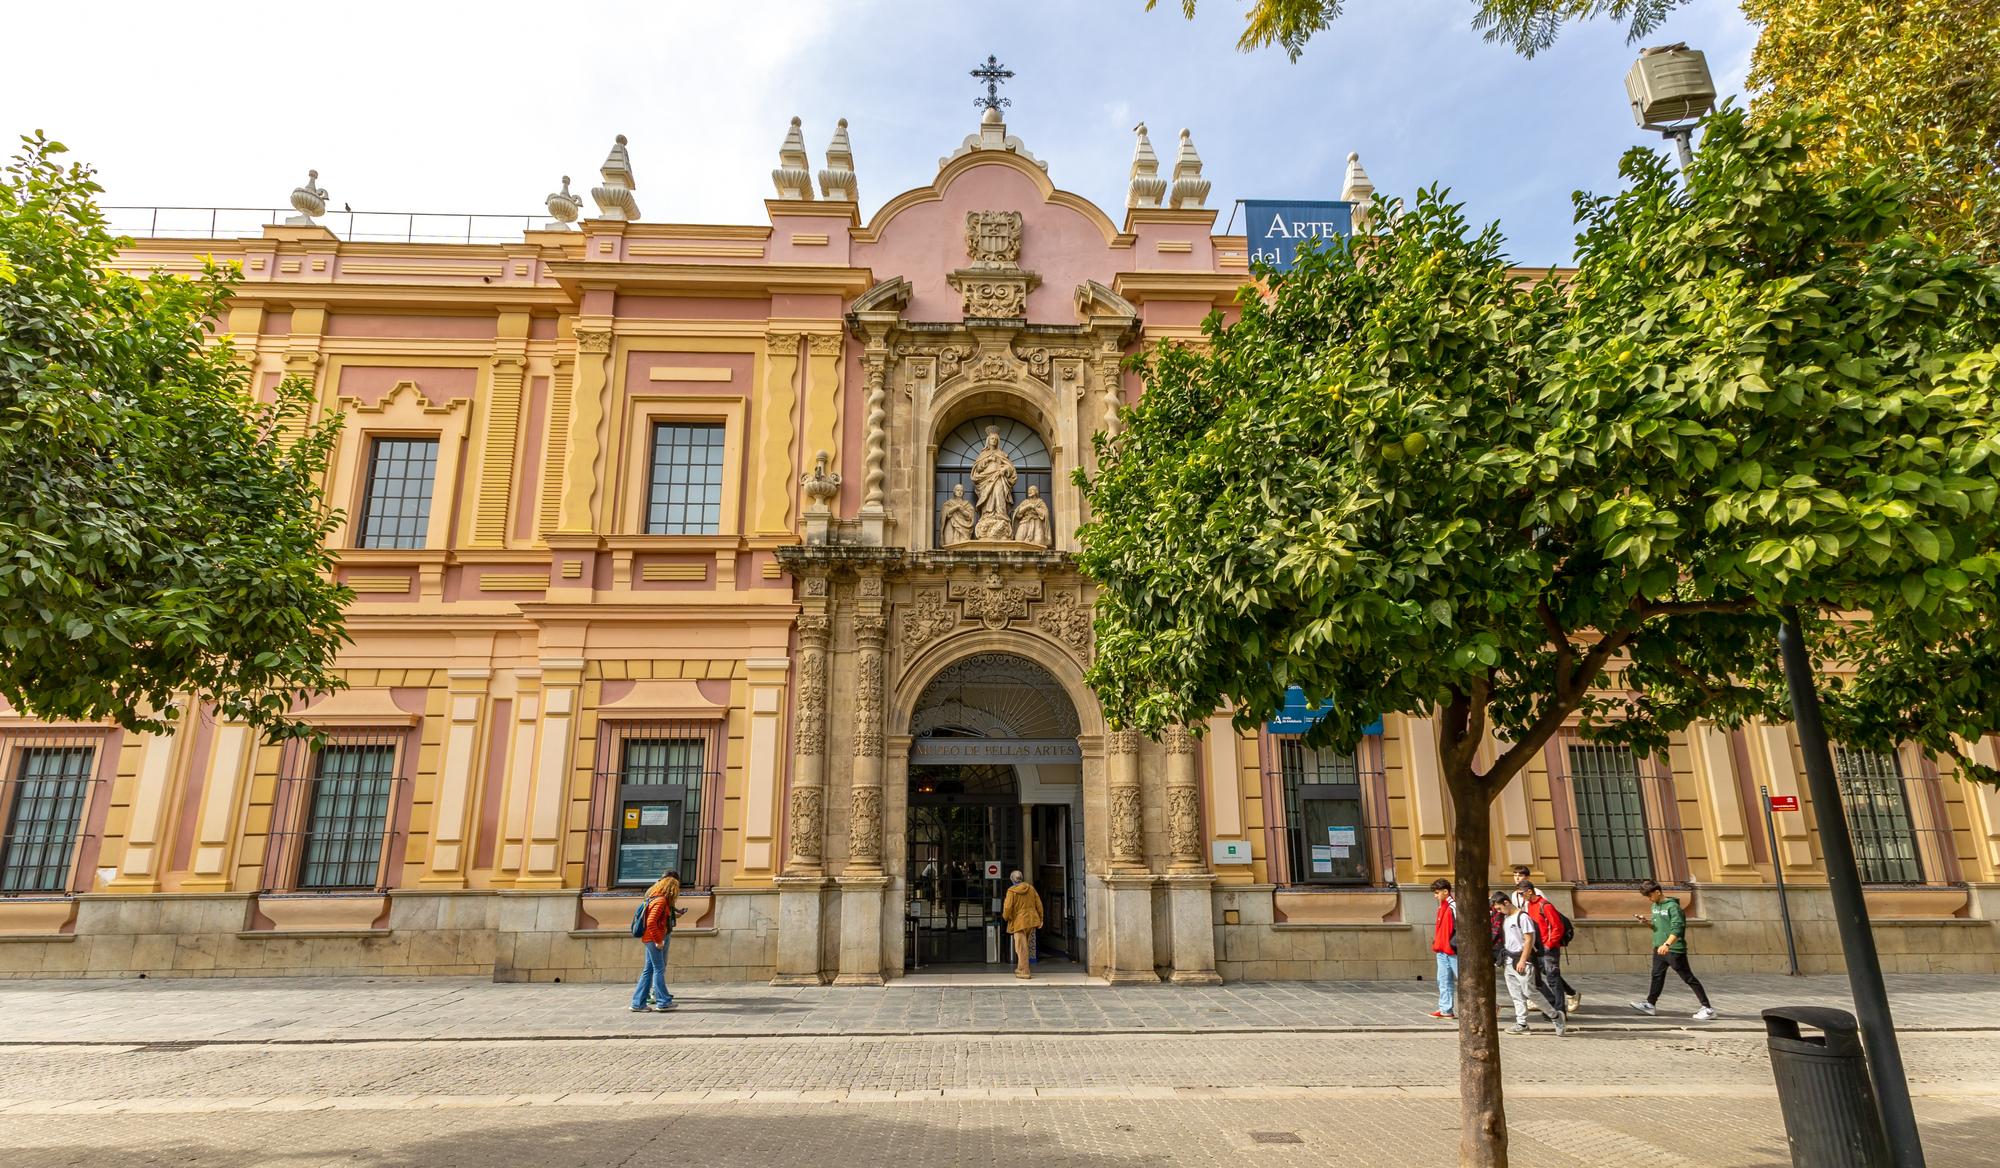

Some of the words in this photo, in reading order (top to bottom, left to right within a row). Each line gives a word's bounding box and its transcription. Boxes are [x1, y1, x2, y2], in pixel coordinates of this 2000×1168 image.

[1264, 213, 1335, 239] ARTE
[1250, 248, 1282, 265] del
[916, 745, 960, 756] MUSEO
[965, 745, 978, 756] DE
[985, 745, 1030, 756] BELLAS
[1033, 745, 1074, 756] ARTES
